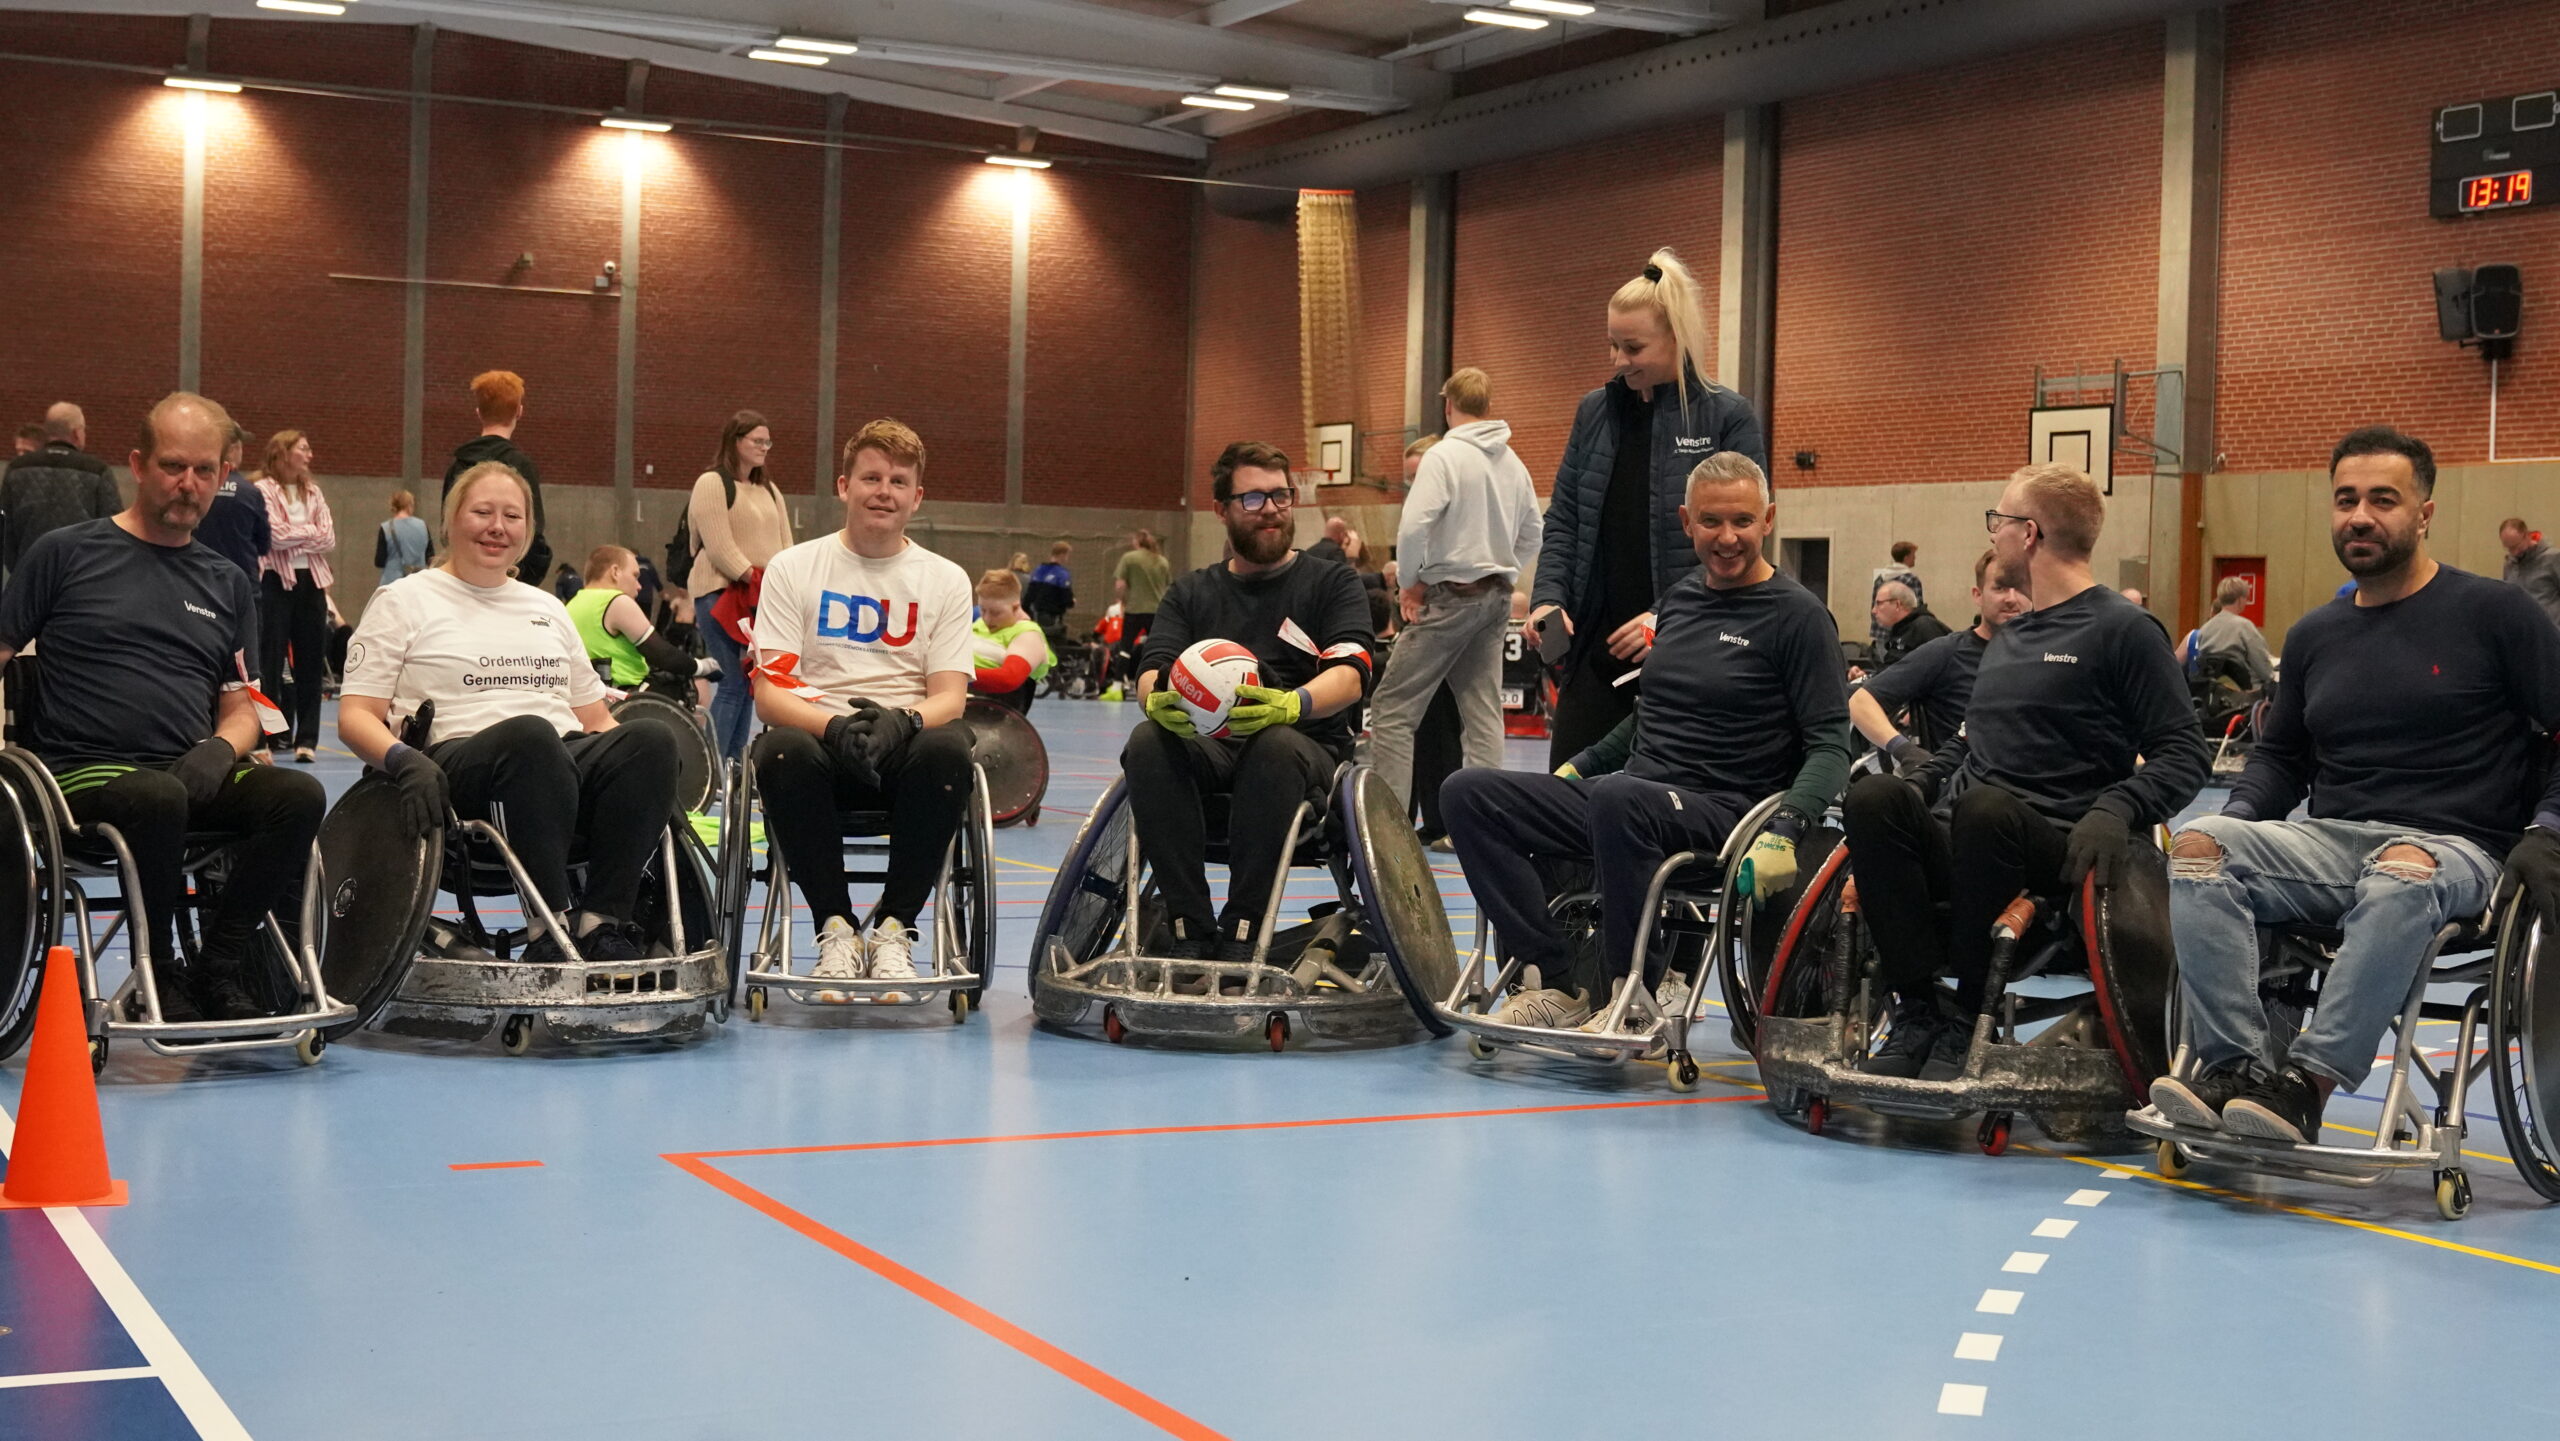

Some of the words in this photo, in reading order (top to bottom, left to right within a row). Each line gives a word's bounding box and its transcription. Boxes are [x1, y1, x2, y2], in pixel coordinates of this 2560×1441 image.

[2468, 172, 2531, 207] 13:19
[1675, 436, 1712, 447] Venstre
[183, 600, 217, 619] Venstre
[817, 590, 919, 647] DDU
[1719, 631, 1750, 646] Venstre
[479, 656, 560, 670] Ordentlighed
[2043, 652, 2078, 664] Venstre
[463, 673, 568, 688] Gennemsigtighed
[1171, 664, 1204, 702] molten
